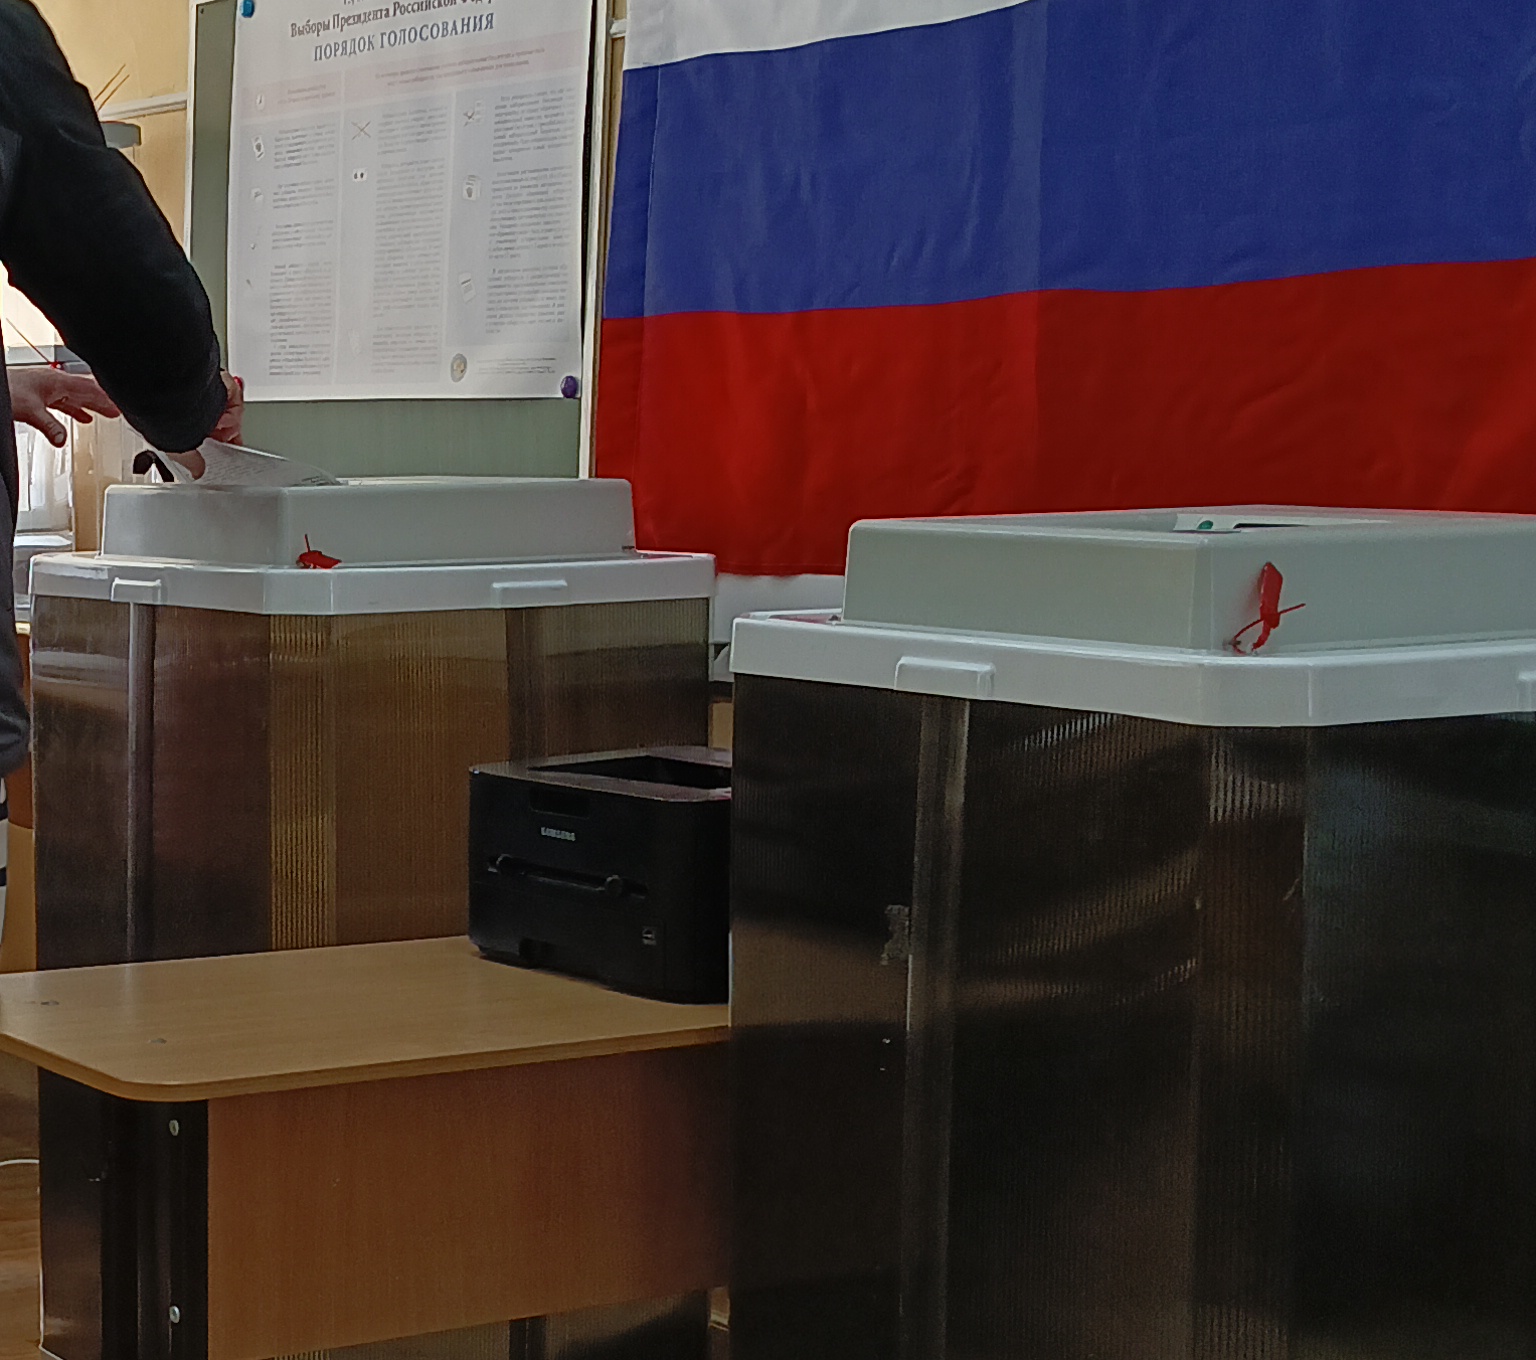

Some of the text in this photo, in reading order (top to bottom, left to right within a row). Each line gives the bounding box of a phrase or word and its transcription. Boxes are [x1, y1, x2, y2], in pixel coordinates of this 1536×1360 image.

[290, 19, 331, 38] Выборы
[332, 6, 391, 33] Президента
[314, 11, 495, 62] ПОРЯДОК ГОЛОСОВАНИЯ
